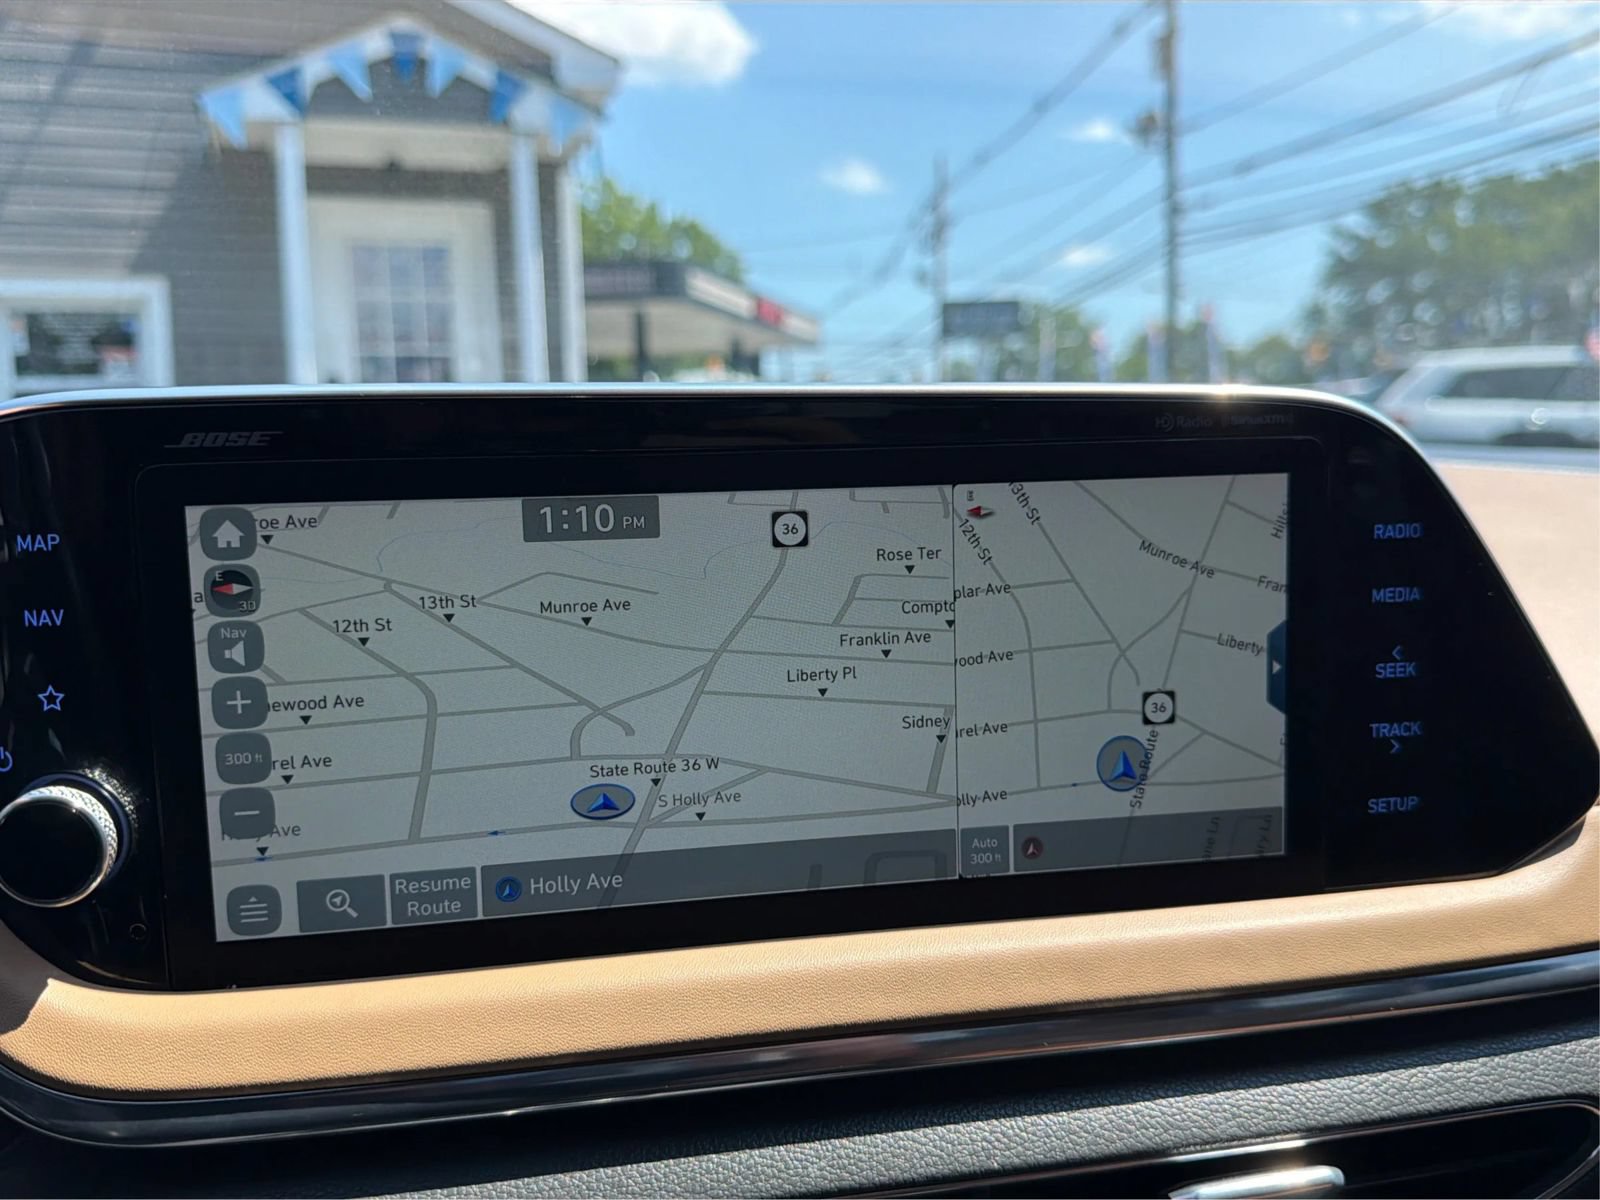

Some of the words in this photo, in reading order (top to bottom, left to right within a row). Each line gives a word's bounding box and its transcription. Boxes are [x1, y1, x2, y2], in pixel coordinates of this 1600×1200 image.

[163, 431, 283, 448] BOSE
[285, 515, 317, 529] Ave
[540, 503, 615, 533] 1:10
[622, 516, 646, 529] PM
[1026, 508, 1041, 525] St
[782, 523, 799, 535] 36
[1373, 523, 1421, 539] RADIO
[16, 533, 60, 552] MAP
[959, 519, 981, 549] 12th
[977, 548, 993, 566] St
[876, 548, 913, 562] Rose
[917, 546, 942, 560] Ter
[1139, 540, 1188, 568] Munroe
[1189, 561, 1215, 579] Ave
[215, 571, 224, 582] E
[985, 583, 1012, 596] Ave
[1371, 587, 1420, 603] MEDIA
[419, 596, 454, 610] 13th
[460, 594, 477, 609] St
[540, 600, 598, 614] Munroe
[602, 598, 631, 612] Ave
[24, 608, 64, 627] NAV
[333, 618, 369, 633] 12th
[375, 617, 392, 632] St
[220, 627, 247, 640] Nav
[840, 631, 900, 647] Franklin
[904, 631, 931, 644] Ave
[1216, 633, 1264, 657] Liberty
[987, 651, 1014, 664] Ave
[787, 668, 838, 683] Liberty
[842, 667, 857, 680] Pl
[1375, 662, 1416, 678] SEEK
[333, 694, 365, 709] Ave
[1151, 702, 1167, 713] 36
[902, 715, 950, 731] Sidney
[982, 720, 1008, 735] Ave
[1369, 721, 1421, 738] TRACK
[225, 752, 251, 766] 300
[272, 756, 296, 770] rel
[301, 755, 332, 769] Ave
[590, 764, 629, 778] State
[634, 761, 676, 776] Route
[682, 759, 702, 772] 36
[705, 757, 720, 770] W
[1130, 775, 1148, 809] State
[1139, 729, 1159, 774] Route
[658, 794, 668, 808] S
[672, 792, 709, 808] Holly
[715, 790, 742, 804] Ave
[982, 789, 1008, 804] Ave
[1367, 796, 1418, 814] SETUP
[271, 822, 302, 837] Ave
[971, 837, 998, 850] Auto
[969, 852, 993, 866] 300
[394, 875, 472, 894] Resume
[530, 875, 581, 896] Holly
[586, 872, 623, 890] Ave
[407, 898, 462, 917] Route
